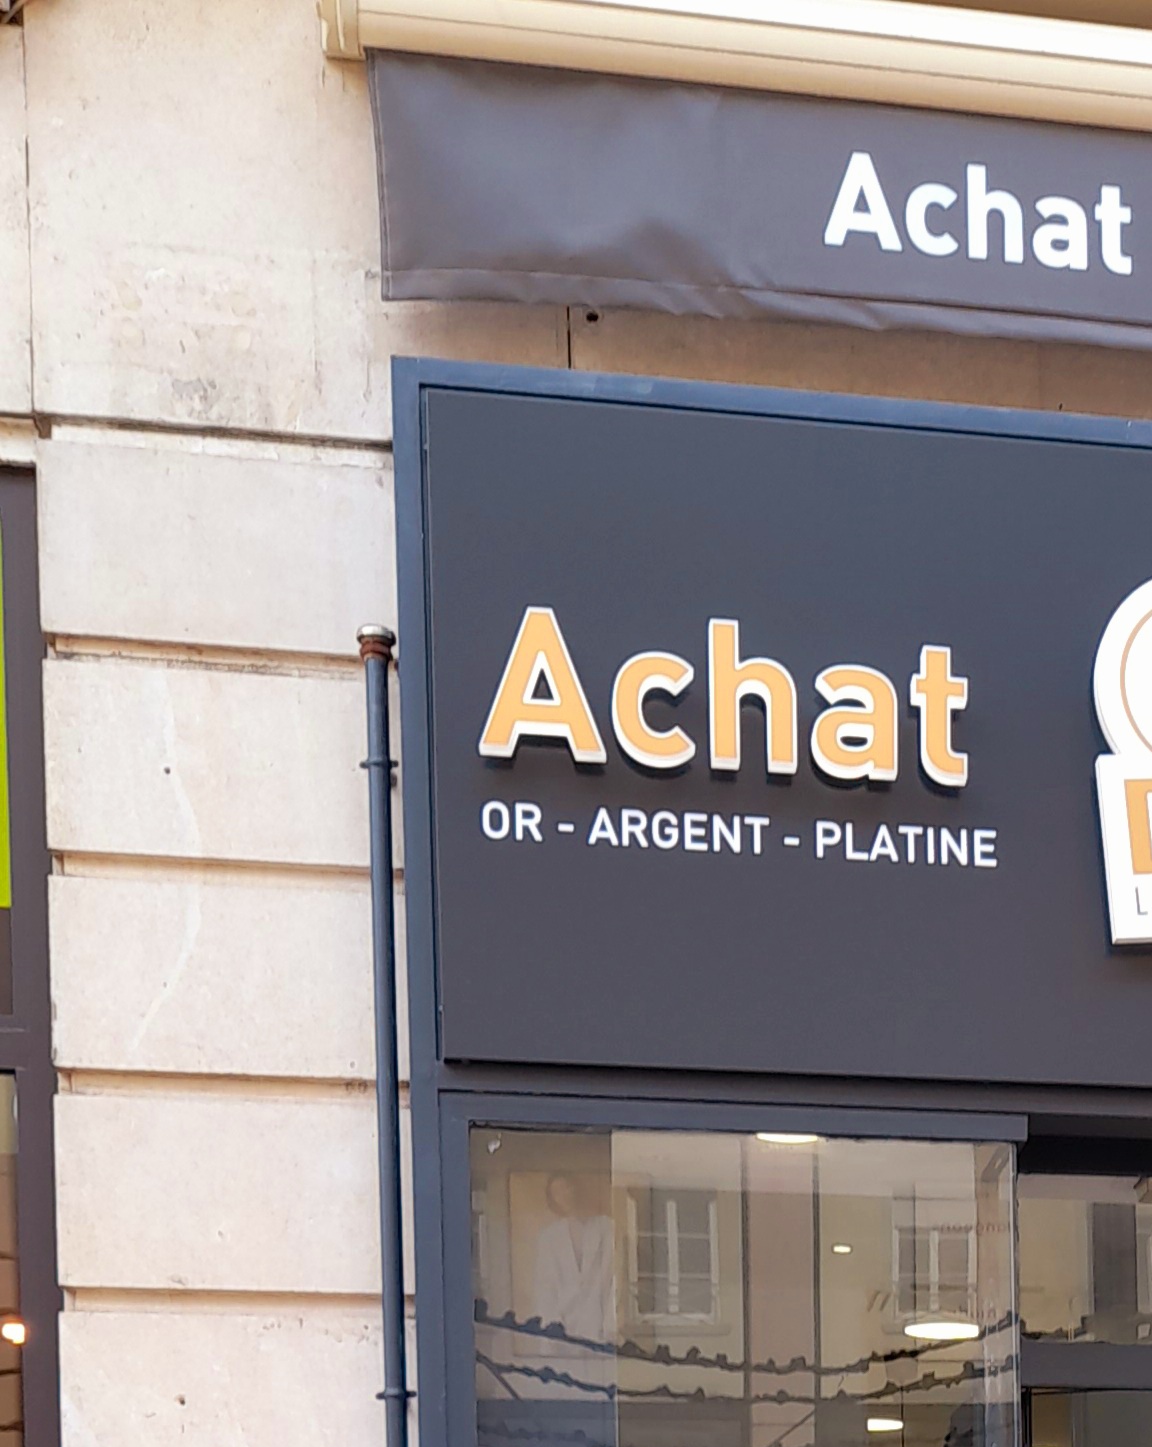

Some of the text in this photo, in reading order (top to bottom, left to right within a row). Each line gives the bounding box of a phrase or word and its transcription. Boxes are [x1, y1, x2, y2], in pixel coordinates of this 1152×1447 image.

[823, 151, 1134, 276] Achat
[478, 605, 969, 787] Achat
[481, 800, 543, 842] OR
[587, 806, 771, 855] ARGENT
[815, 820, 999, 868] PLATINE
